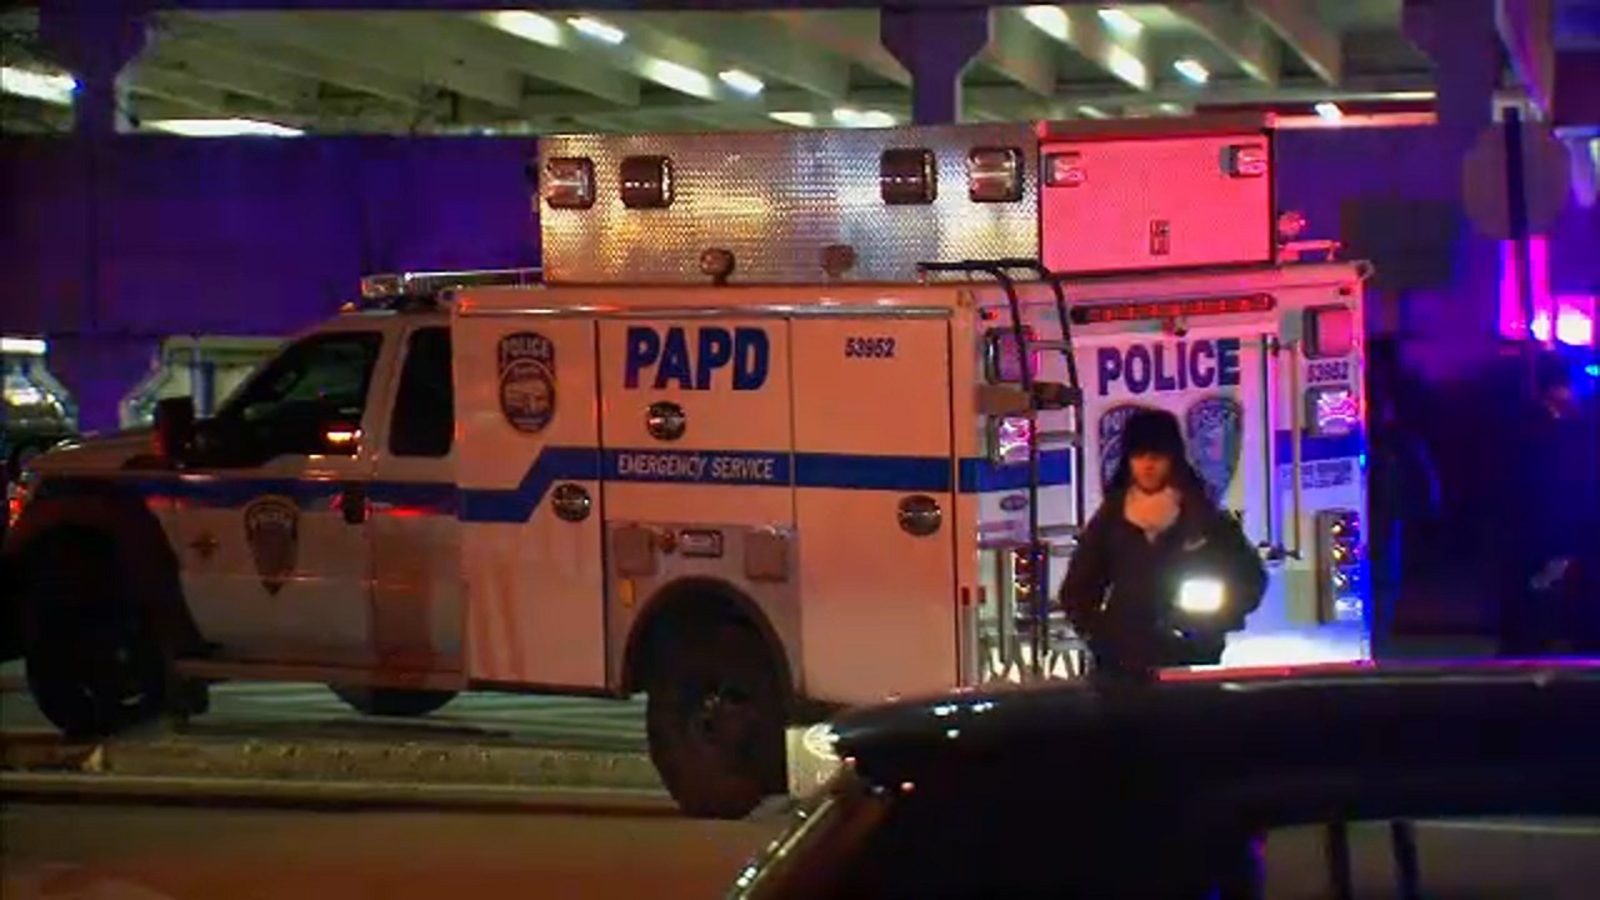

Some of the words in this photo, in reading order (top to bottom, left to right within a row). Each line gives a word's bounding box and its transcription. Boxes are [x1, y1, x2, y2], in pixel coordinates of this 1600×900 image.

[502, 337, 550, 360] POLICE
[624, 327, 770, 390] PAPD
[844, 337, 896, 358] 53952
[1097, 338, 1241, 395] POLICE
[617, 454, 708, 477] EMERGENCY
[711, 456, 775, 479] SERVICE
